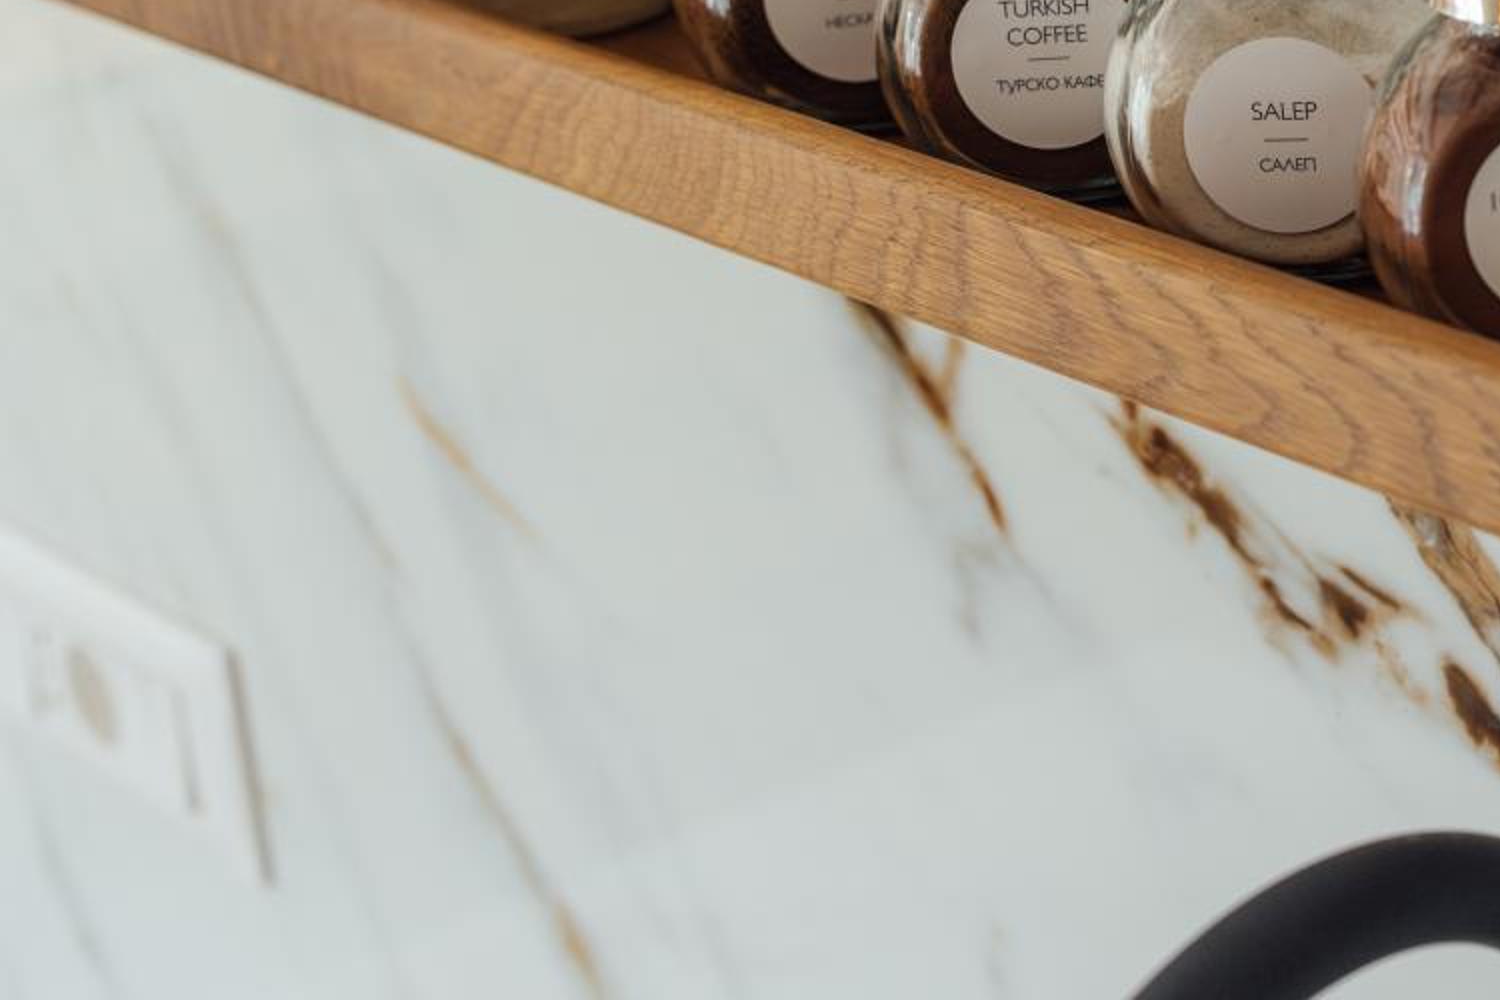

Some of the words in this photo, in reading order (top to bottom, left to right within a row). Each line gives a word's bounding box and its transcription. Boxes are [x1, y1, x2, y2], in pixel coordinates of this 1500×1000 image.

[1006, 23, 1088, 47] COFFEE
[995, 75, 1060, 95] ТУРСКО
[1250, 100, 1318, 121] SALEP
